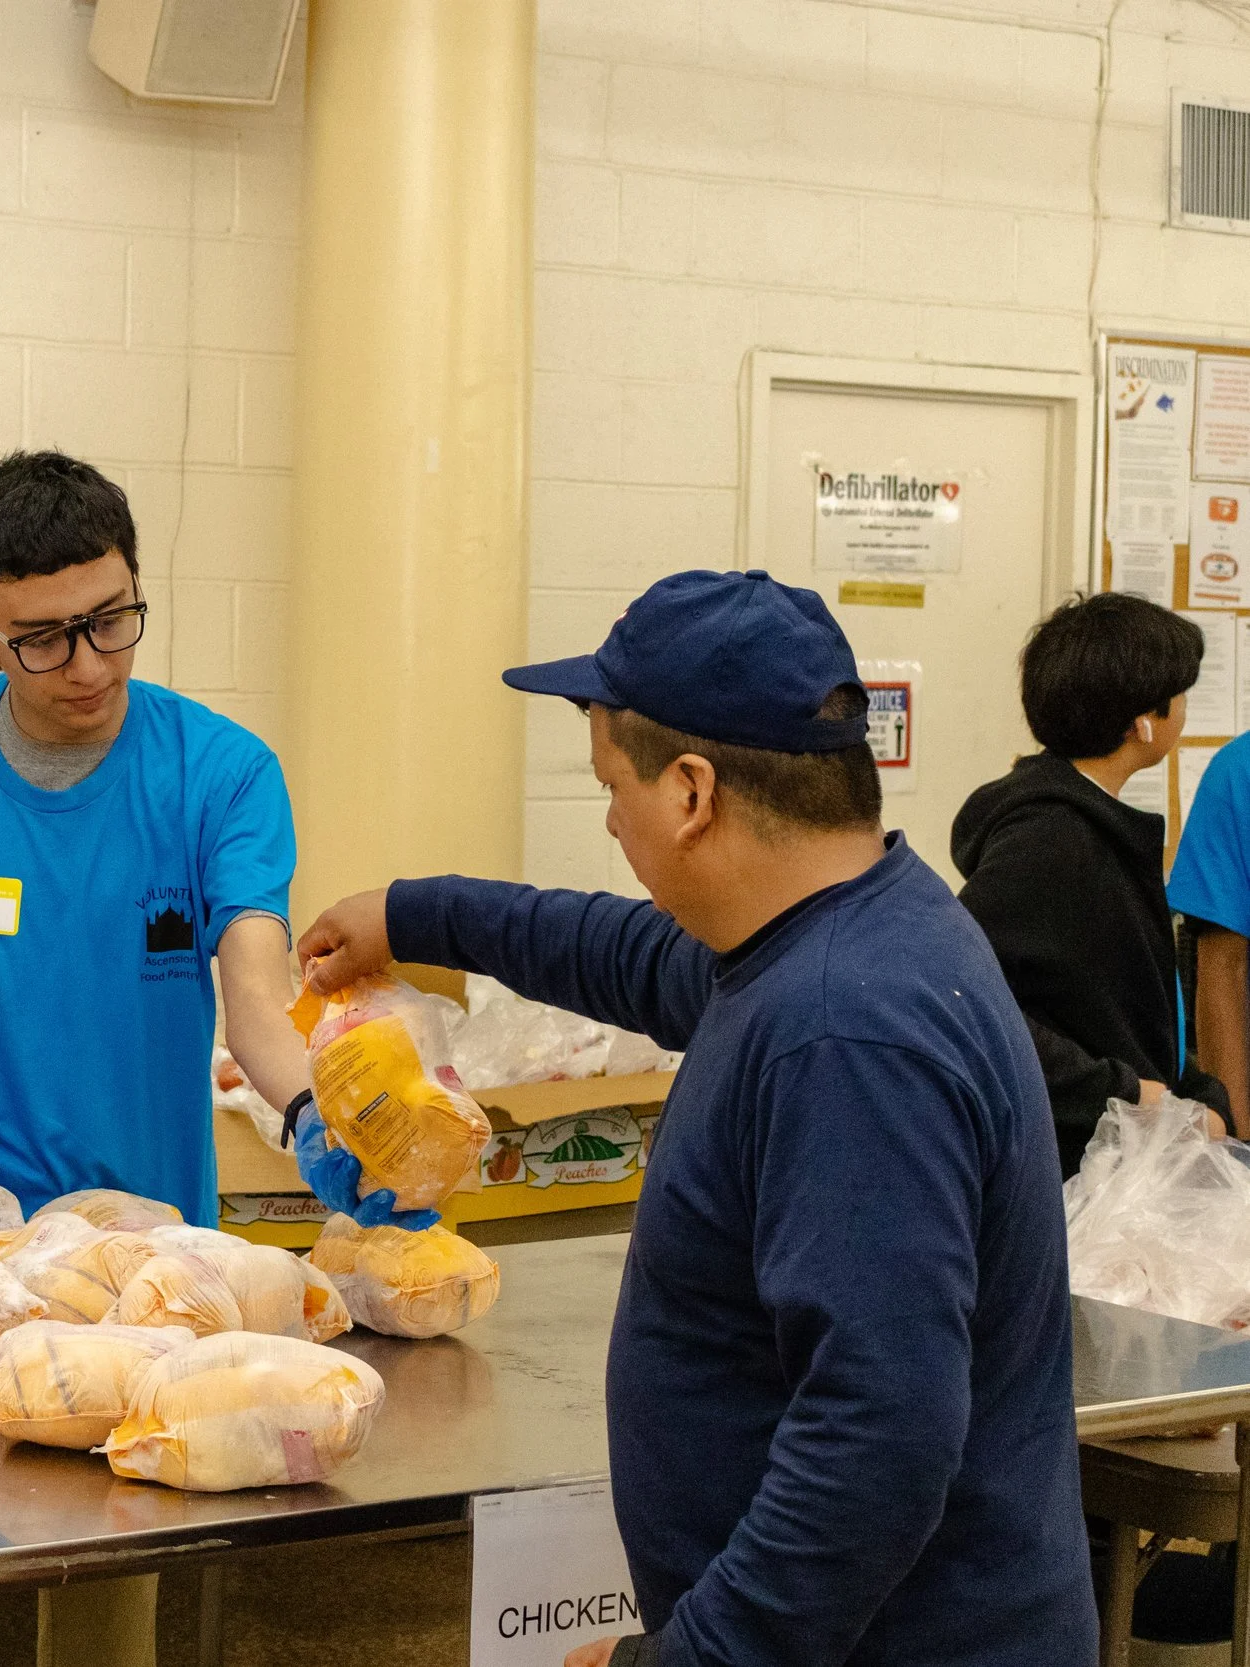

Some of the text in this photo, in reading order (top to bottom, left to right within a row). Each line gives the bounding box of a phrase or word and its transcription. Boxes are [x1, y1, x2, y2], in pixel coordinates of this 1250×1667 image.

[820, 472, 940, 501] Defibrillator
[145, 955, 197, 966] Ascension
[141, 969, 200, 982] Food Pantry
[555, 1163, 607, 1180] Peaches
[258, 1200, 327, 1216] Peaches
[498, 1592, 638, 1638] CHICKEN
